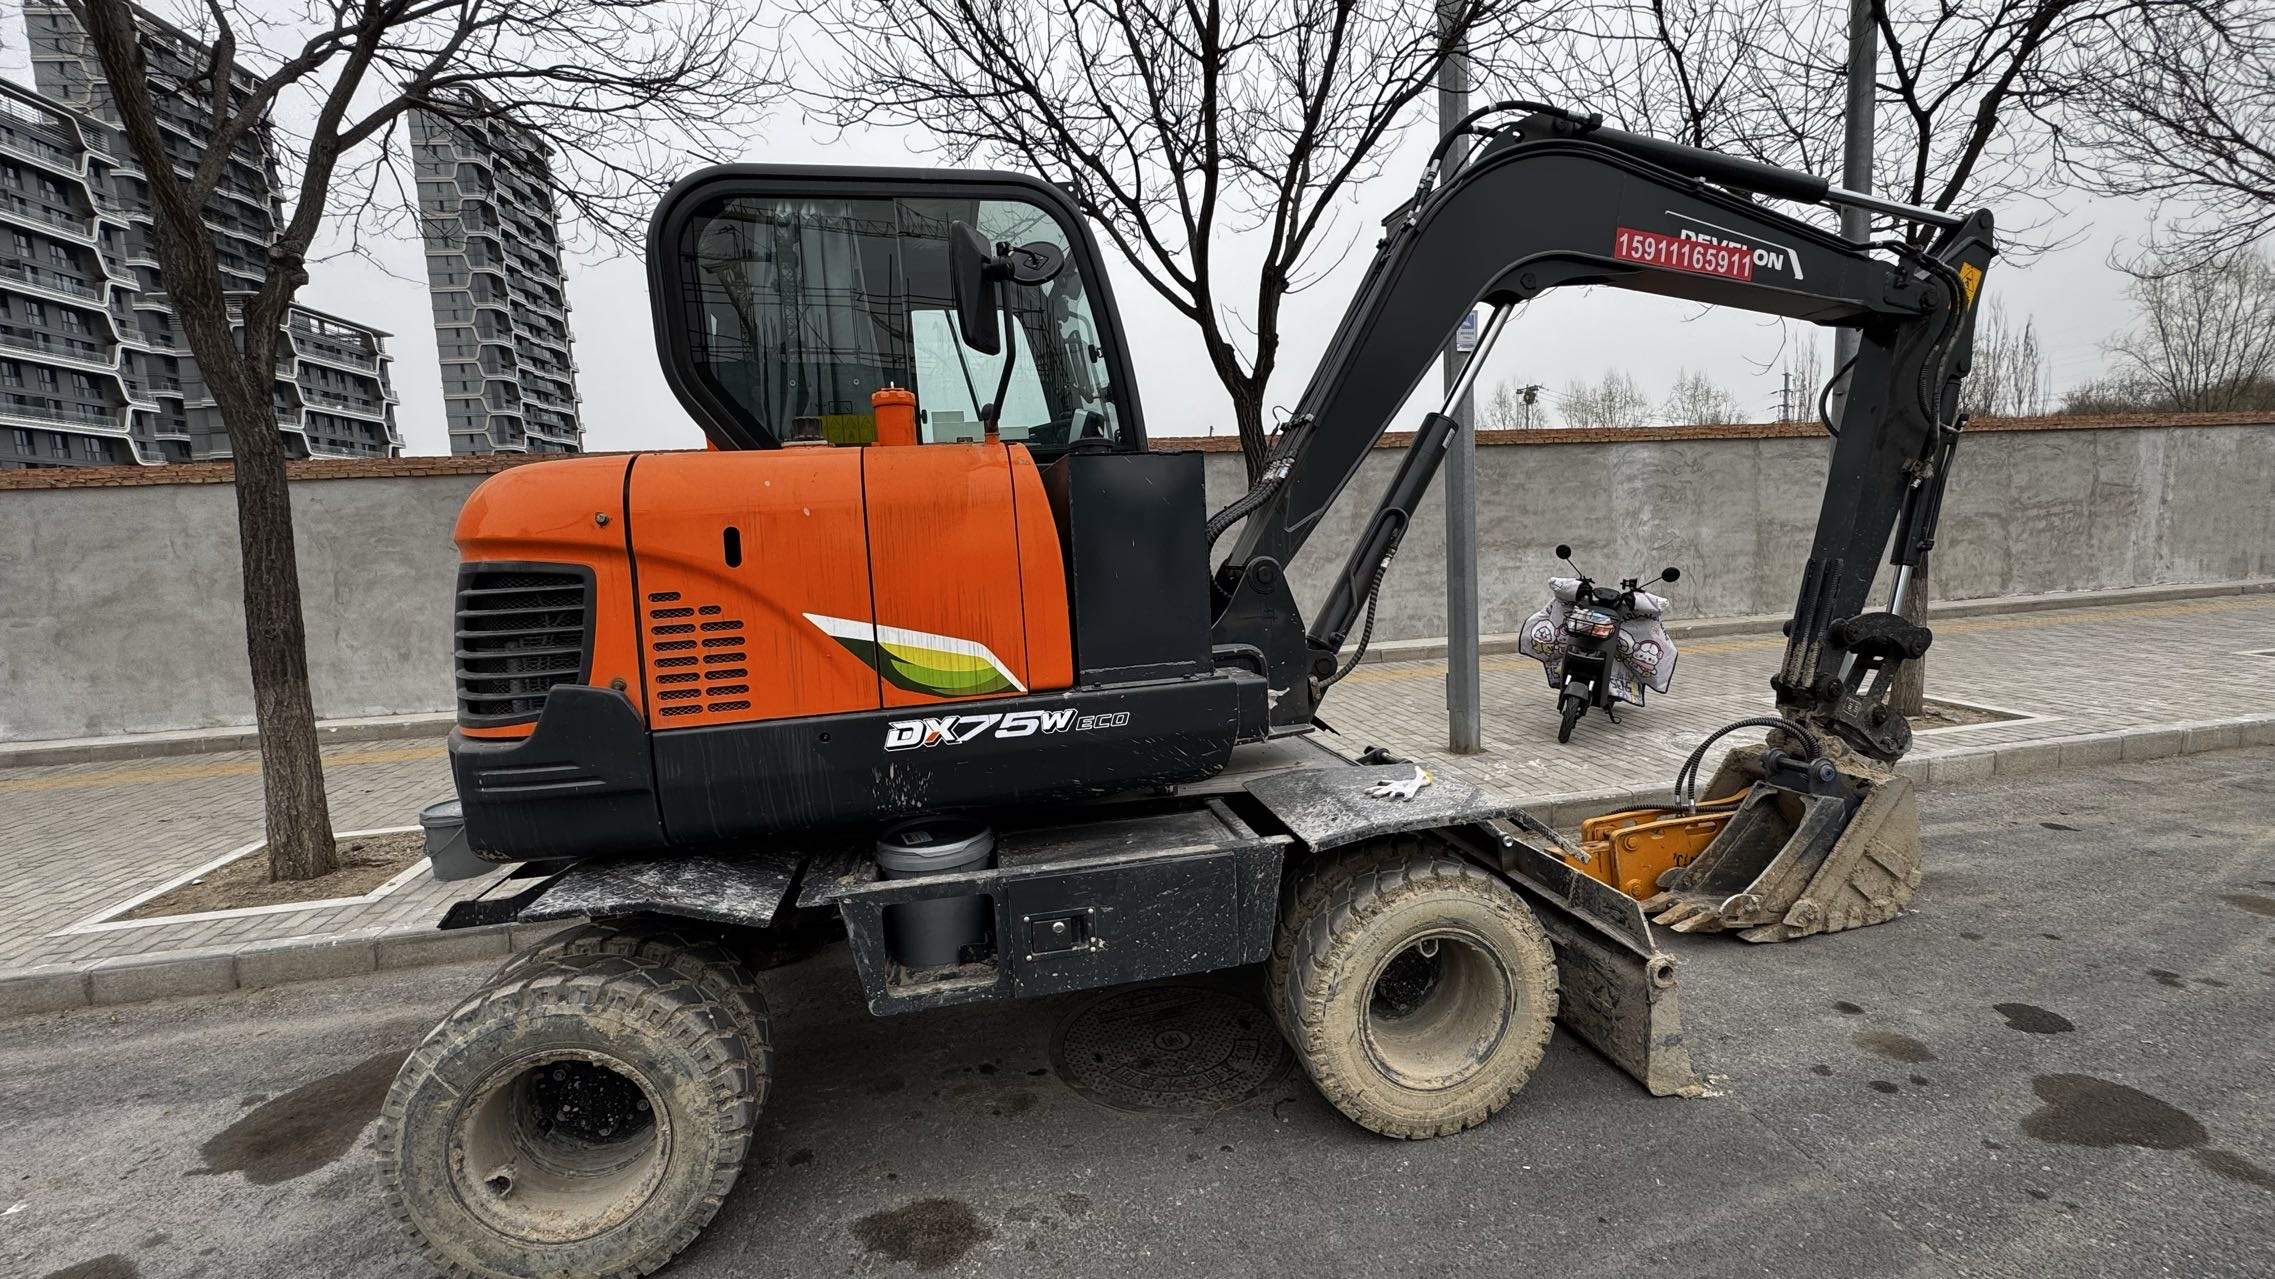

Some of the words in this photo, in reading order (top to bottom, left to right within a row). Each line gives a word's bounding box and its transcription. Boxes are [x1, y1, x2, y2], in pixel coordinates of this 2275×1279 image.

[1619, 233, 1751, 277] 15911165911
[884, 708, 1078, 751] DX75W
[1076, 711, 1130, 731] ECO
